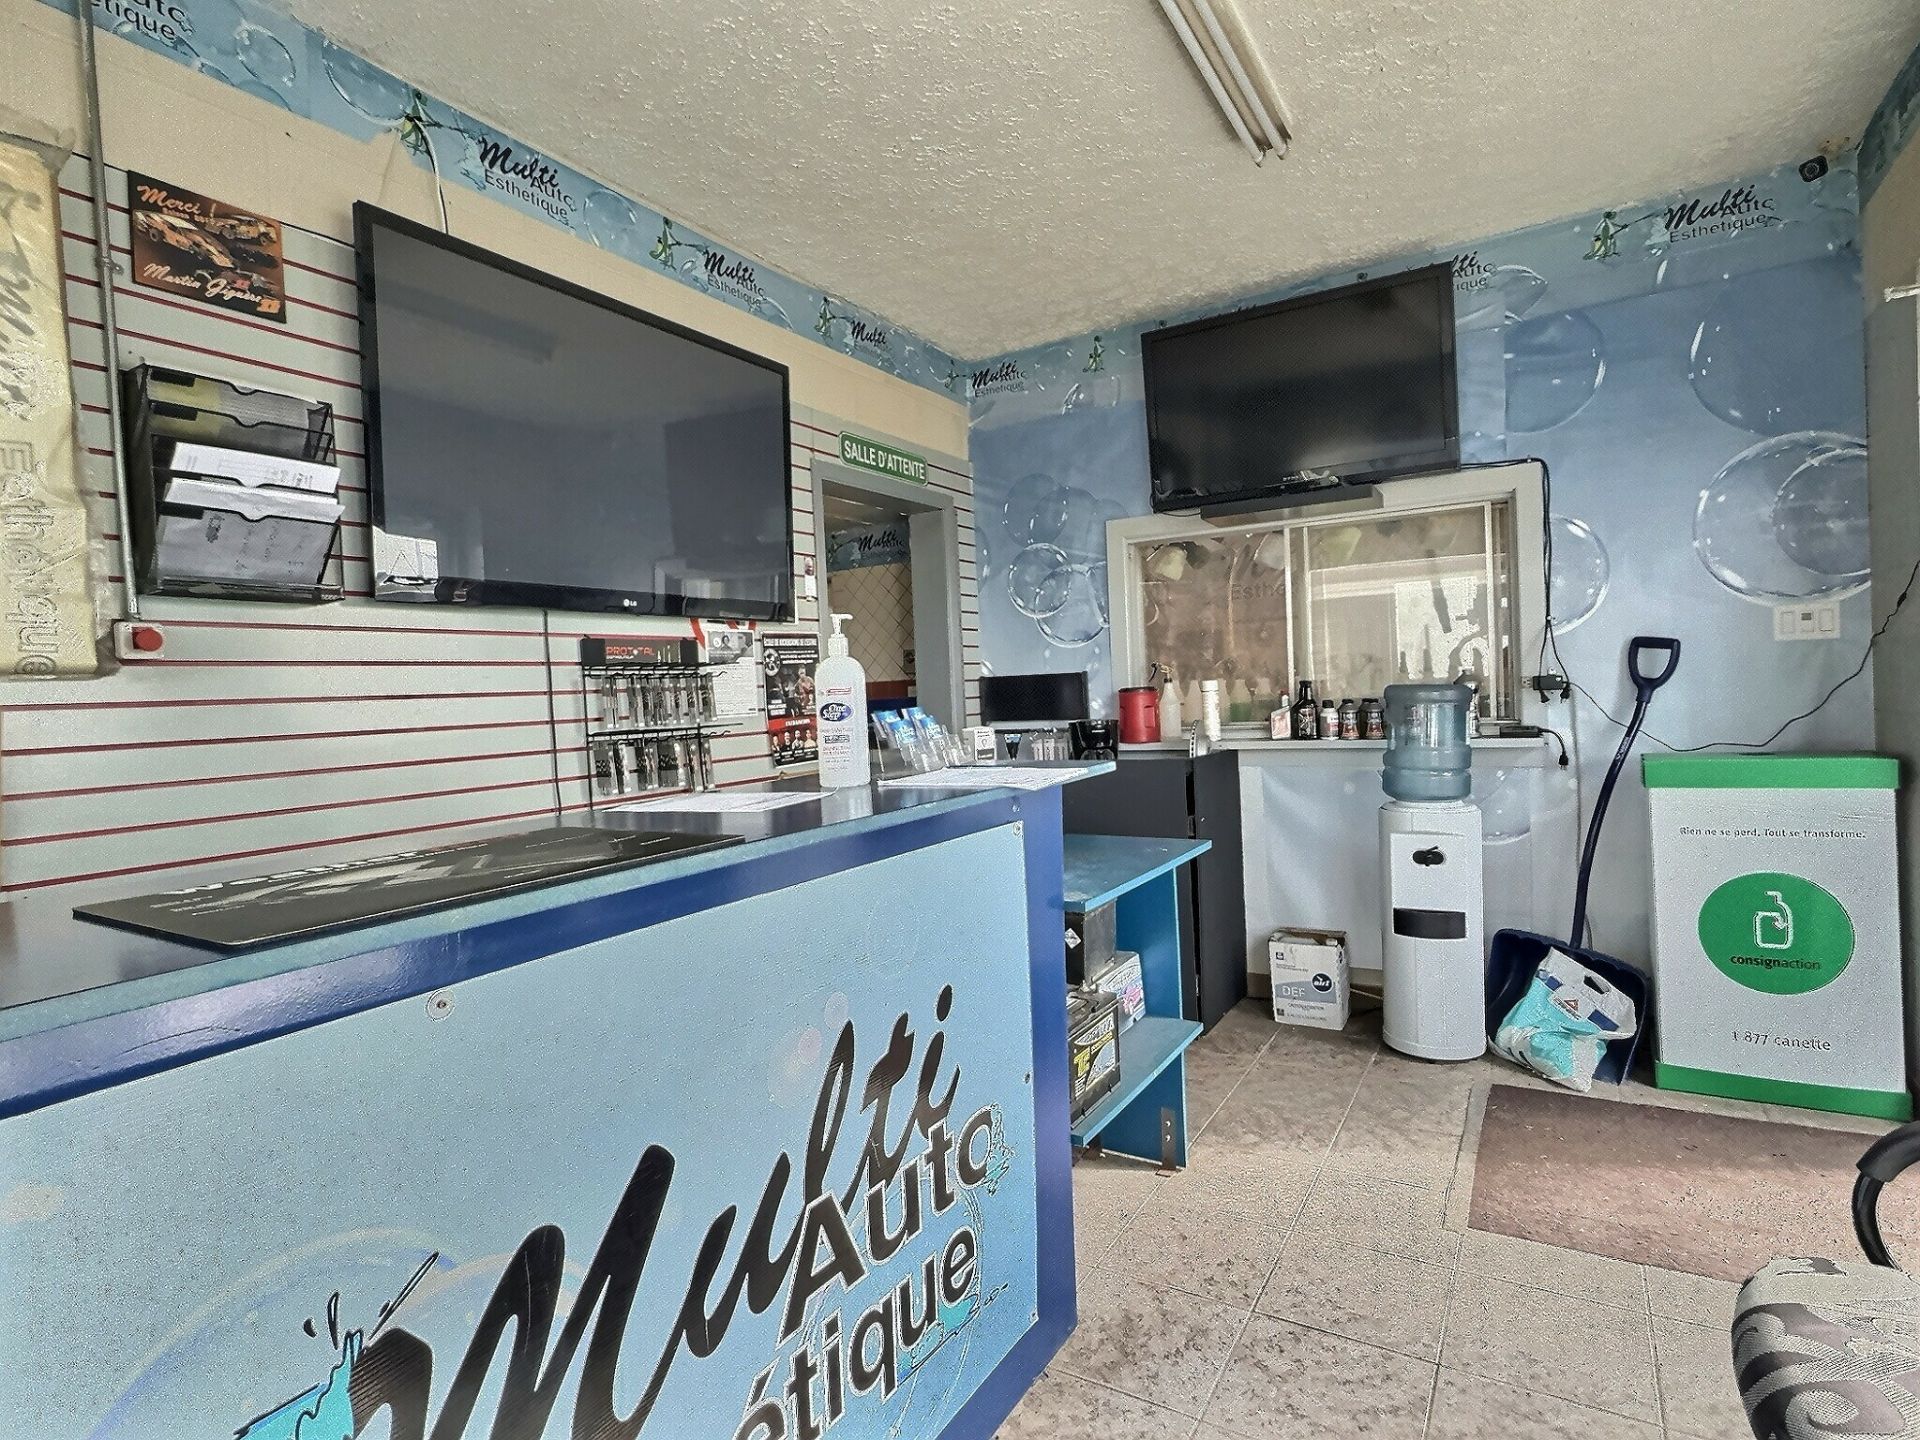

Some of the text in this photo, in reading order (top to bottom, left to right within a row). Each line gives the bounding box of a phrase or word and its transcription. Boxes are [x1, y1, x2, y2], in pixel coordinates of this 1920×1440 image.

[478, 136, 559, 188] Multi
[137, 186, 201, 214] Merci
[1664, 184, 1756, 231] Multi
[702, 249, 755, 284] Multi
[851, 320, 886, 345] Multi
[972, 360, 1017, 389] Multi
[844, 440, 925, 480] SALLE D'ATTENTE
[858, 529, 898, 552] Multi
[1679, 827, 1701, 836] Rien
[1764, 829, 1786, 837] Tout
[1789, 830, 1800, 838] se
[1730, 955, 1821, 970] consignaction
[1282, 985, 1305, 997] DEF
[1744, 1031, 1769, 1045] 877
[1774, 1034, 1831, 1051] canette
[348, 984, 960, 1440] Multi
[776, 1103, 994, 1347] Auto
[732, 1227, 977, 1440] étique
